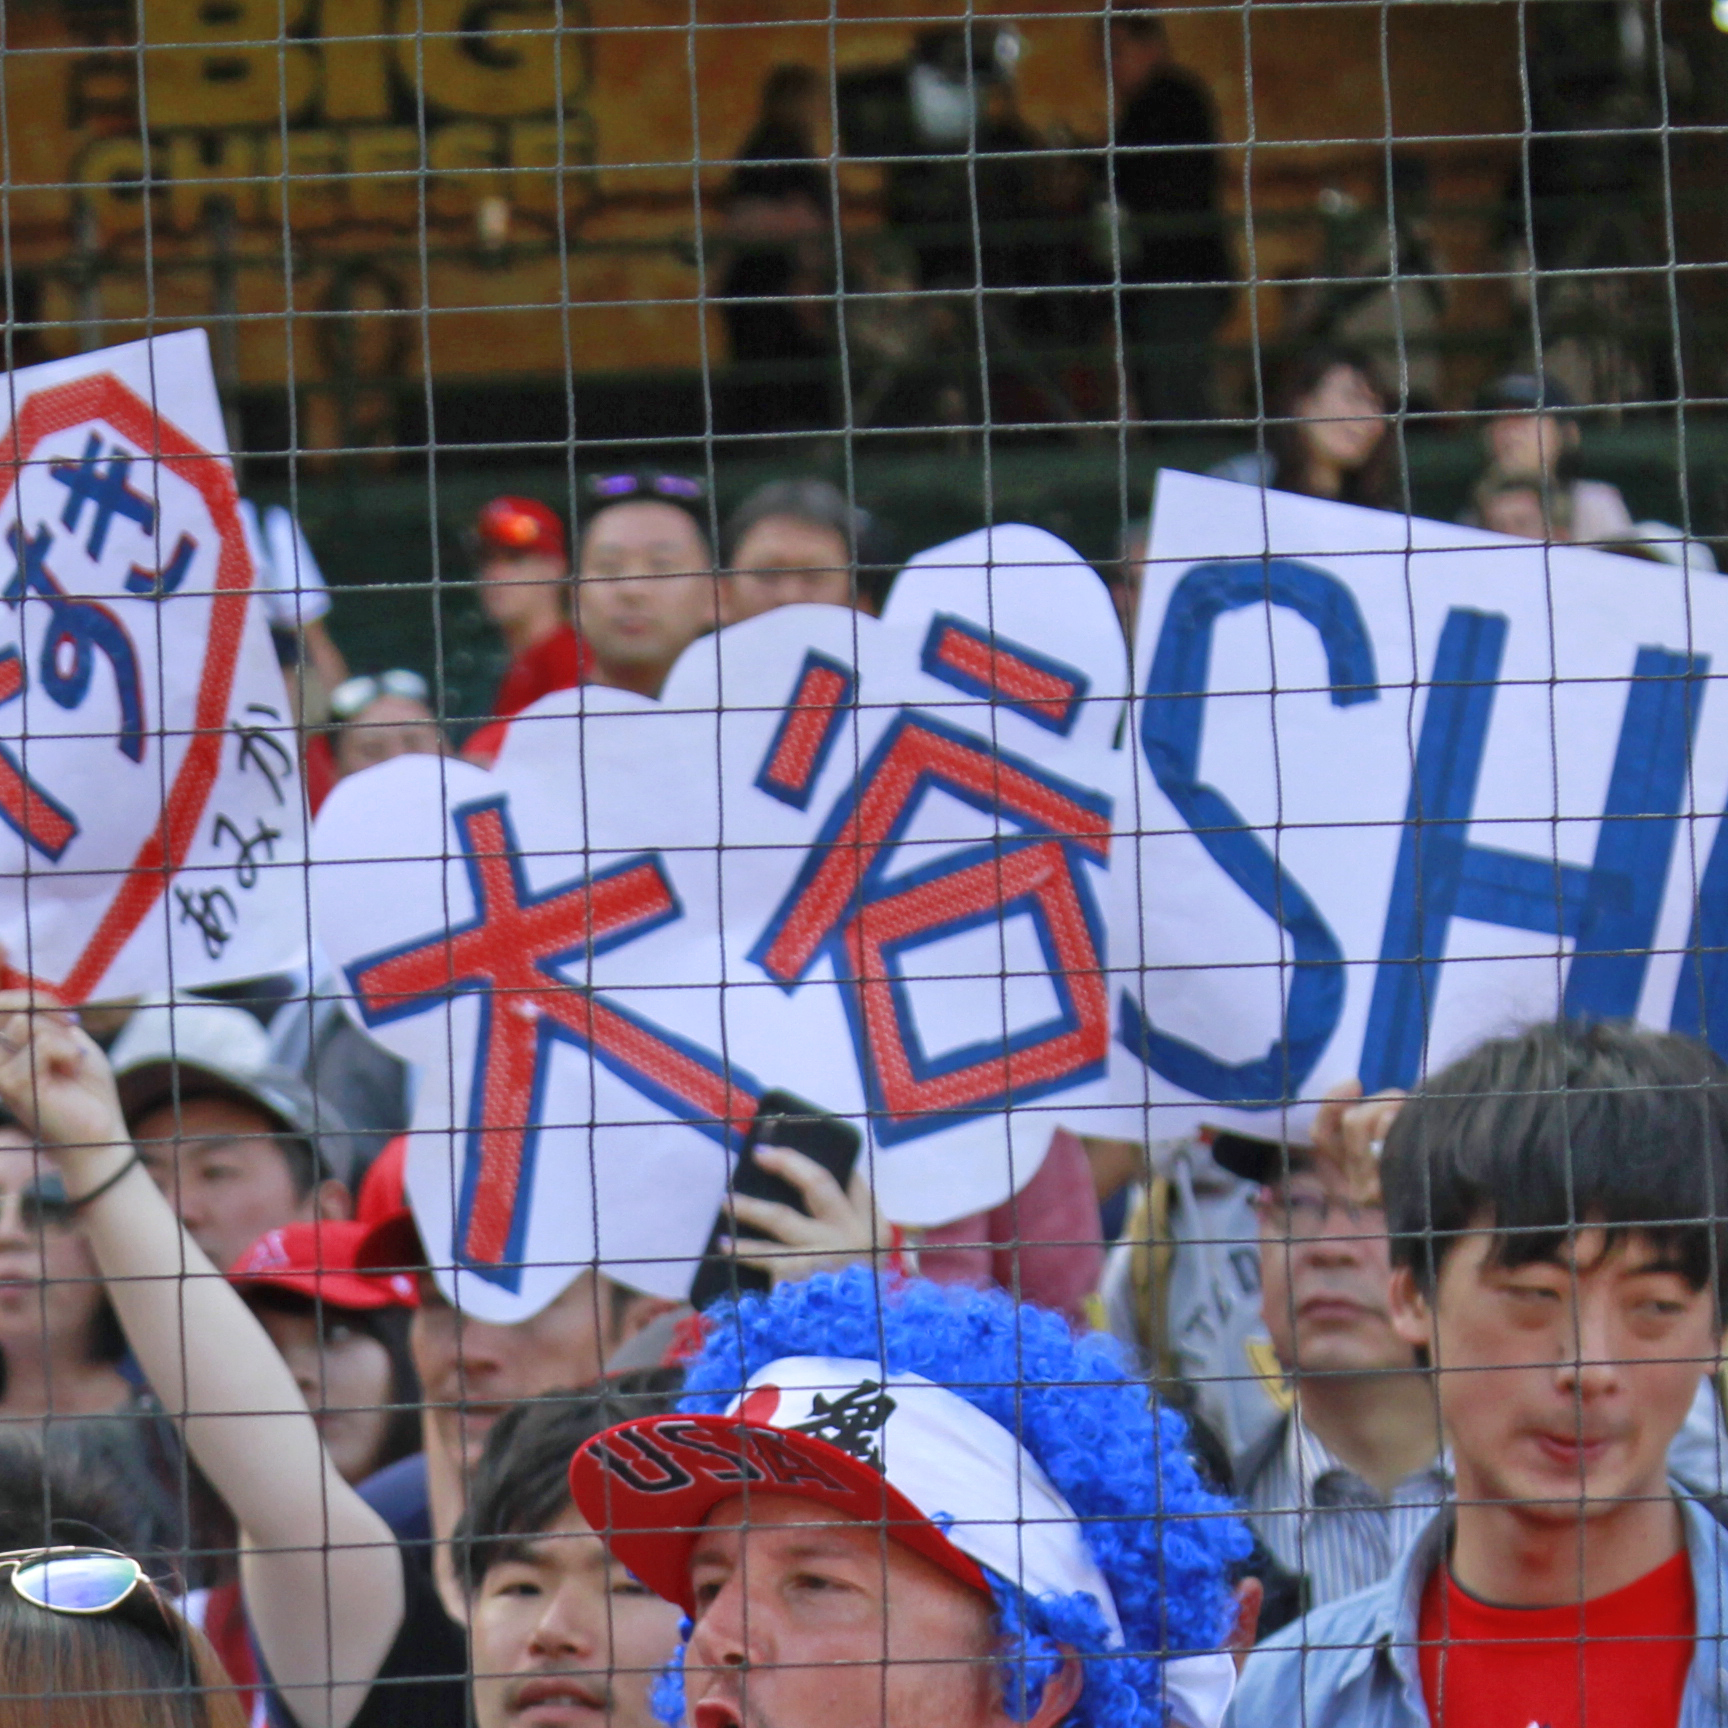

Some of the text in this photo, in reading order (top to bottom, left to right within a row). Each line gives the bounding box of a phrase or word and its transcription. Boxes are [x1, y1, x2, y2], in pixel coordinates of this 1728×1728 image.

[142, 0, 584, 126] BIG
[344, 610, 1114, 1296] 大谷
[584, 1420, 856, 1495] USA
